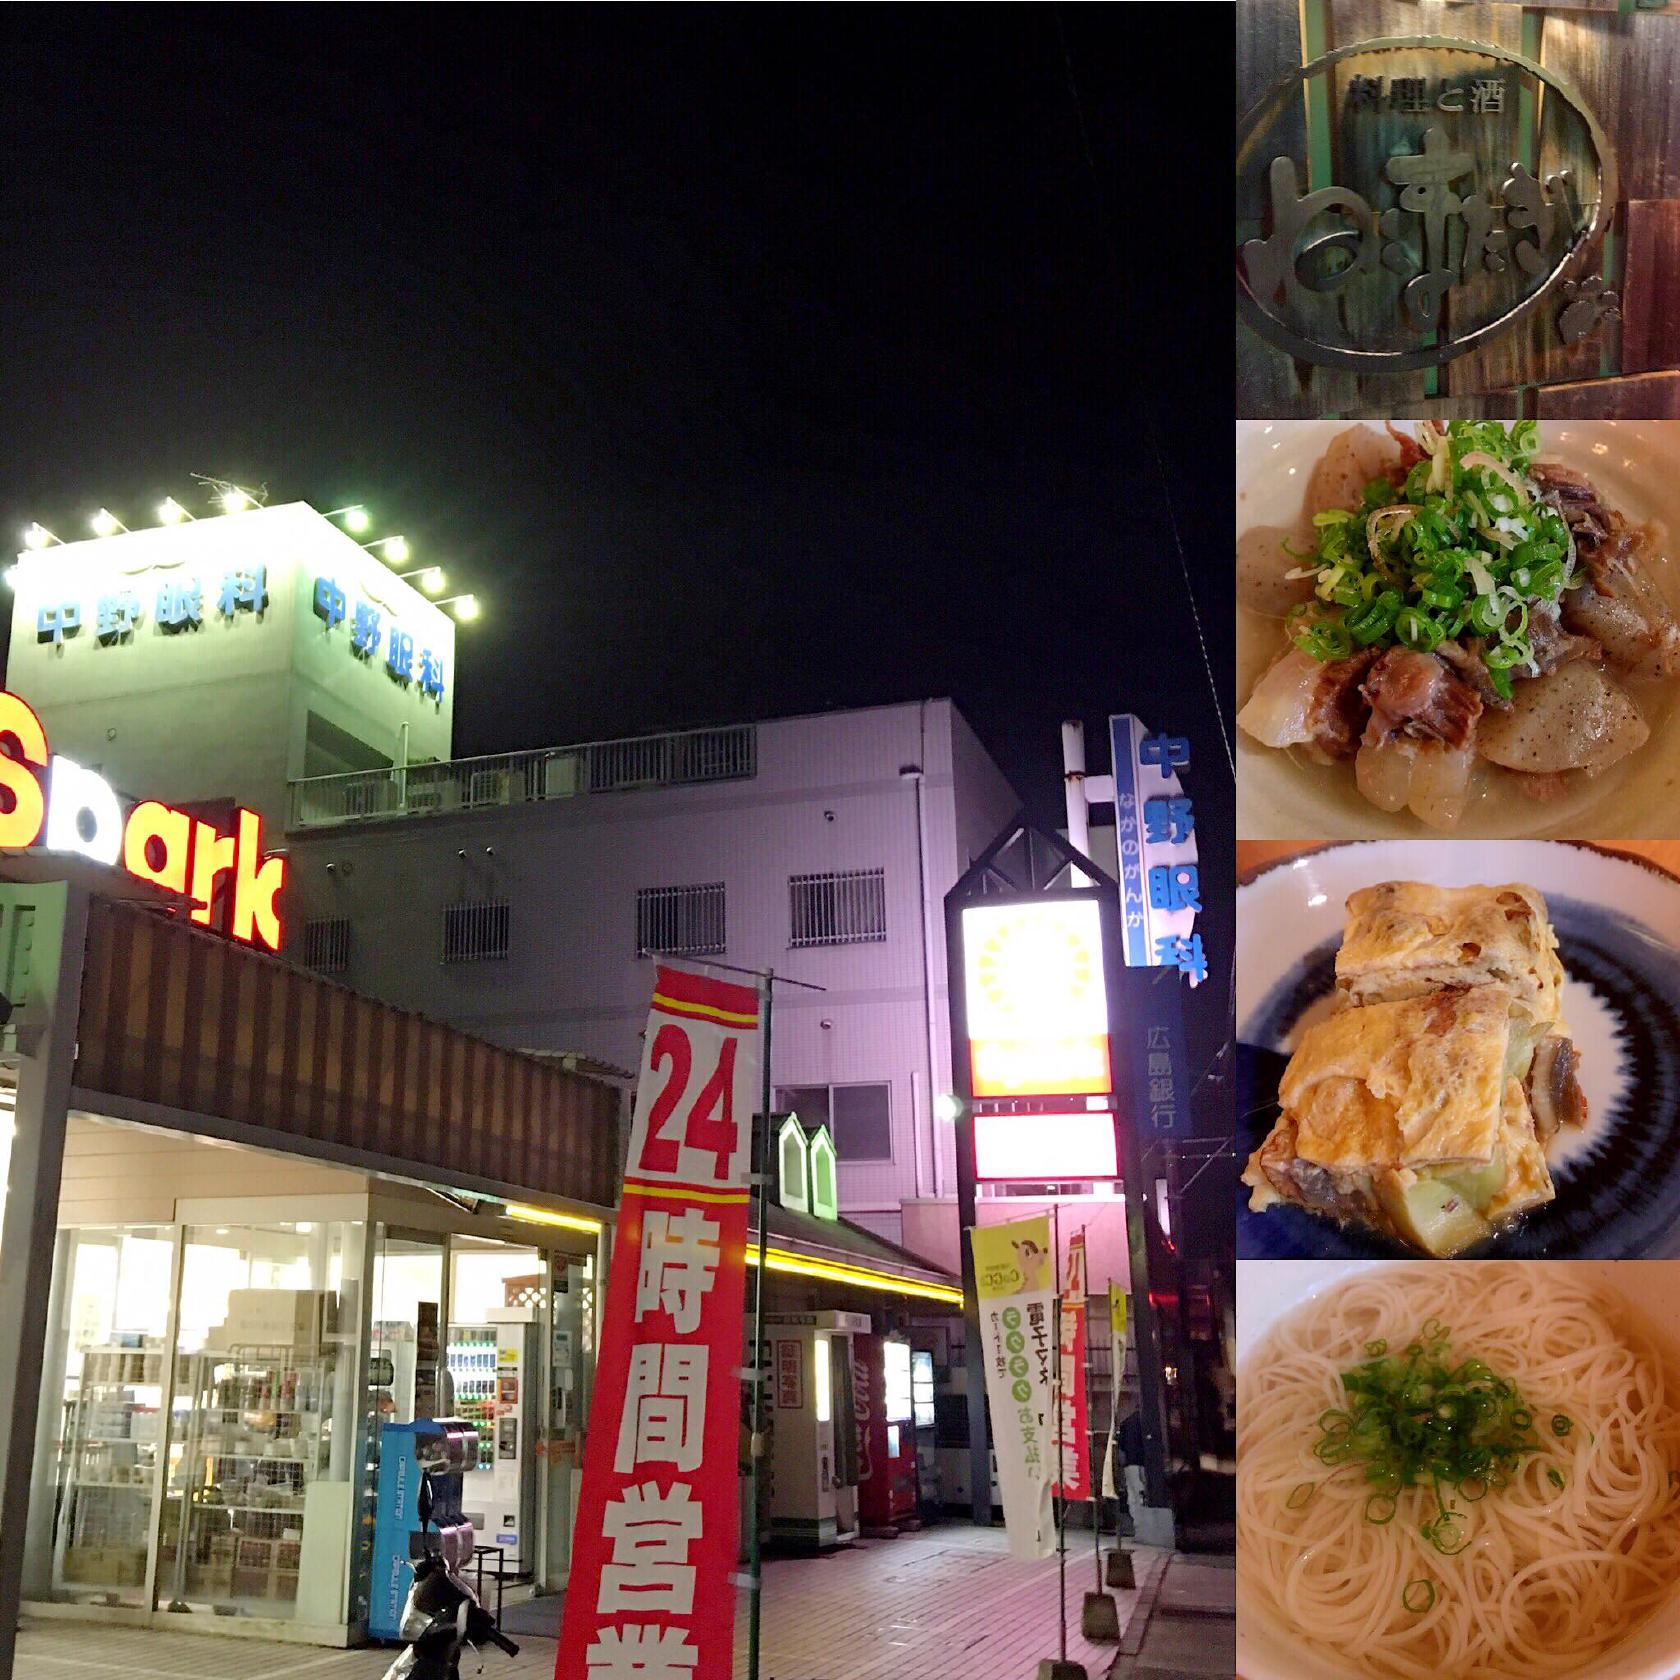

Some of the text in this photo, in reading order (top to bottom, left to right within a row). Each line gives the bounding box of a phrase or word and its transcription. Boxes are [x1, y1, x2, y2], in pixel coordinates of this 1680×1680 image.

[1350, 74, 1505, 112] 料理と酒
[37, 566, 268, 643] 中野眼科
[313, 576, 445, 703] 中野眼科
[1119, 793, 1143, 928] なかのがんか
[1139, 732, 1207, 987] 中野眼科
[640, 1023, 738, 1180] 24
[1147, 1026, 1176, 1129] 広島銀行
